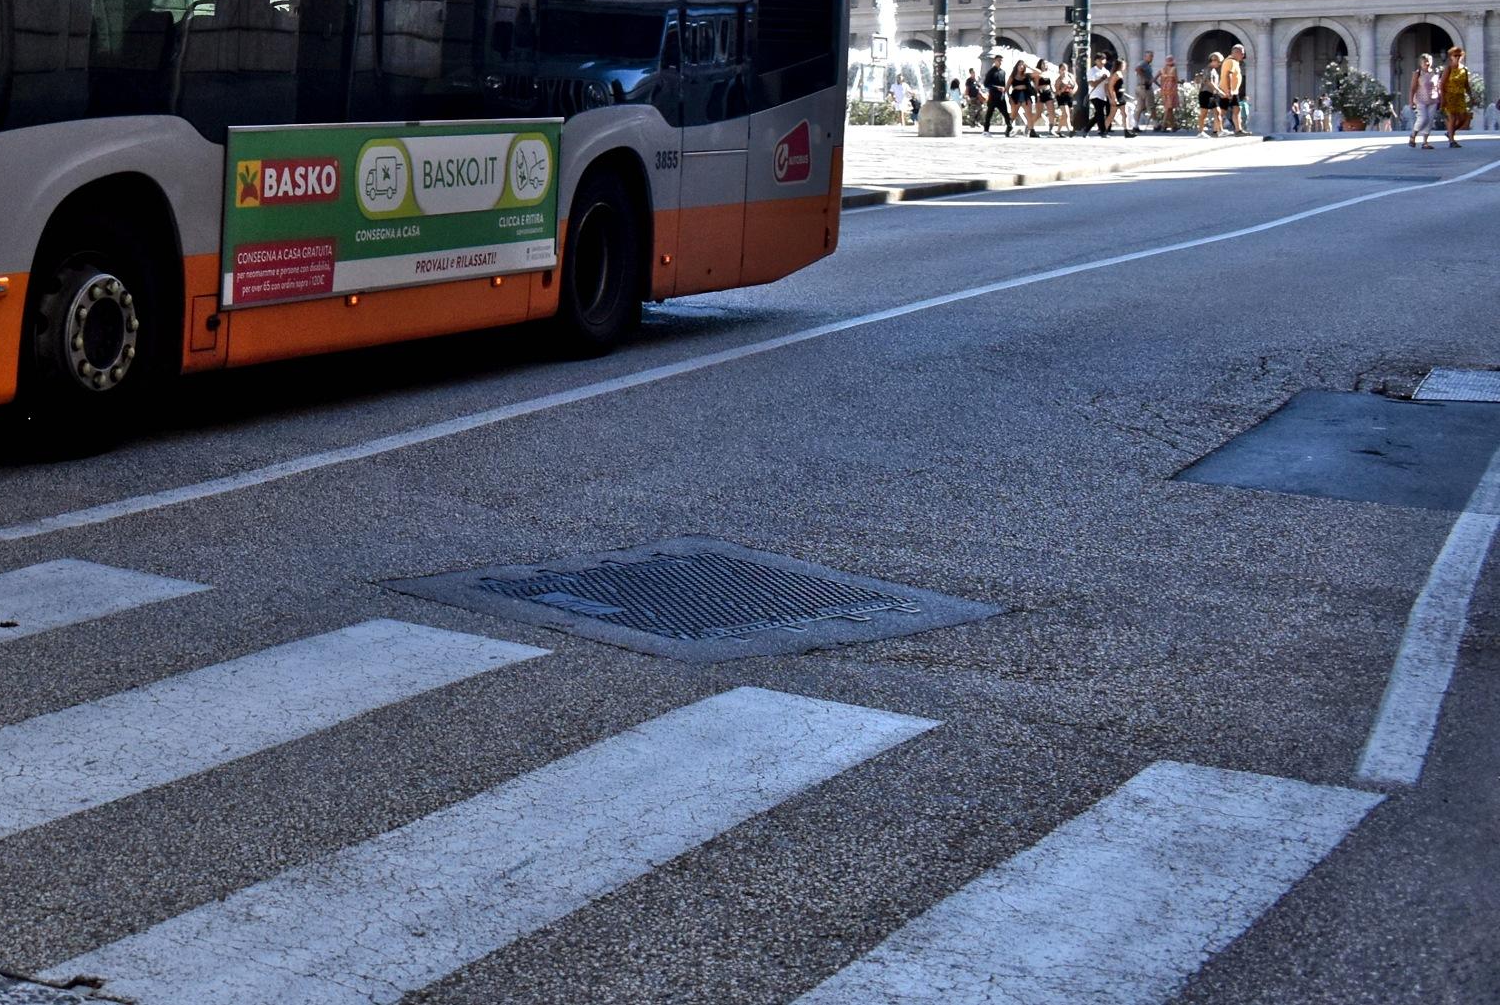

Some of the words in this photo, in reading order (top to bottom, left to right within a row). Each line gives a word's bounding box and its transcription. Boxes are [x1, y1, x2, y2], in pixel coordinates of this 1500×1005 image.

[655, 150, 678, 170] 3855
[264, 165, 336, 197] BASKO
[423, 157, 497, 189] BASKO.IT
[499, 215, 520, 228] CLICCA
[521, 214, 525, 226] E
[355, 228, 395, 242] CONSEGNA
[396, 227, 402, 239] A
[402, 225, 420, 237] CASA
[237, 250, 276, 264] CONSEGNA
[277, 249, 282, 260] A
[283, 248, 301, 260] CASA
[302, 245, 333, 259] GRATUITA
[415, 257, 449, 273] PROVALI
[450, 258, 455, 268] e
[455, 252, 497, 269] RILASSATI!
[237, 272, 246, 283] per
[242, 285, 251, 297] per
[251, 284, 262, 293] over
[263, 280, 271, 291] 65
